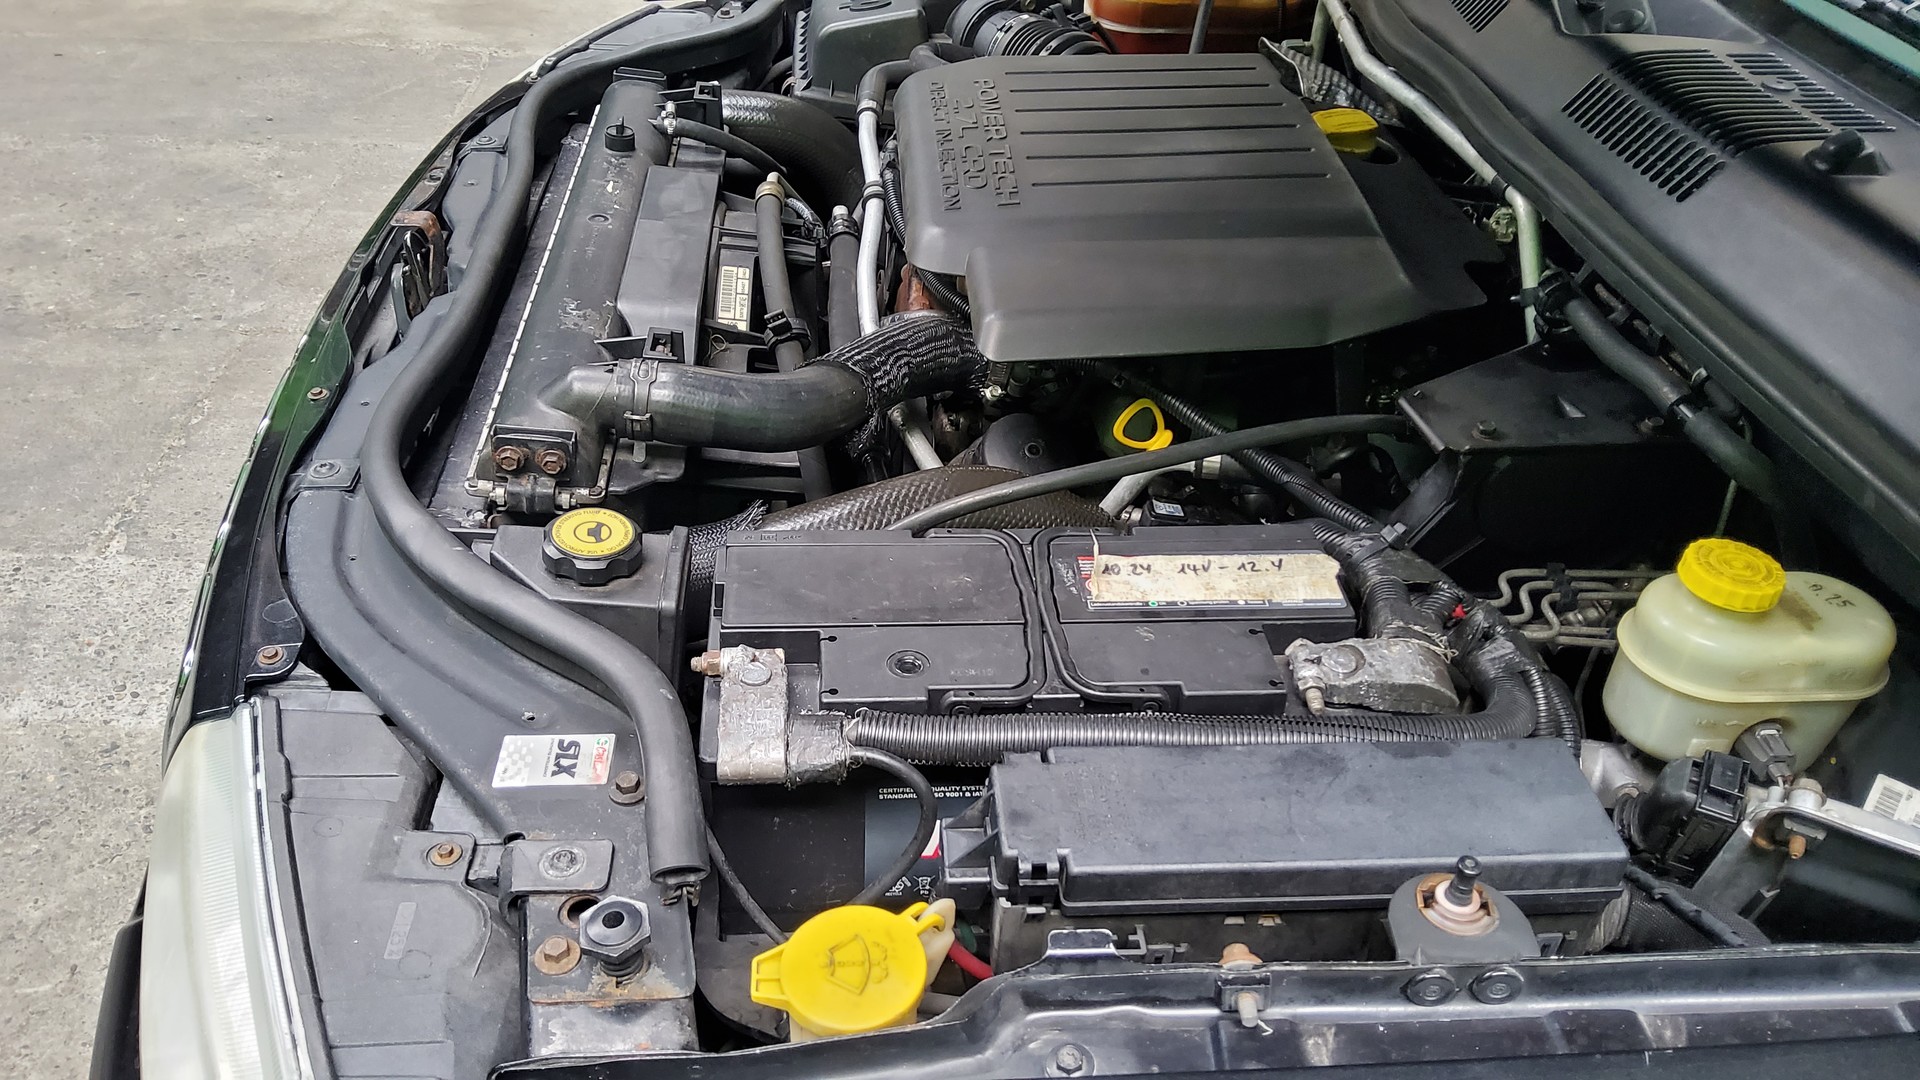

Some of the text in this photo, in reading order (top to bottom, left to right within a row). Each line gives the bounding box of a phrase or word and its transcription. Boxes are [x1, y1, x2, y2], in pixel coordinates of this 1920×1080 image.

[929, 82, 962, 212] DIRECT INJECTION
[953, 98, 988, 190] 2.7L CRD
[973, 78, 1021, 207] POWER TECH
[550, 738, 581, 779] SLX
